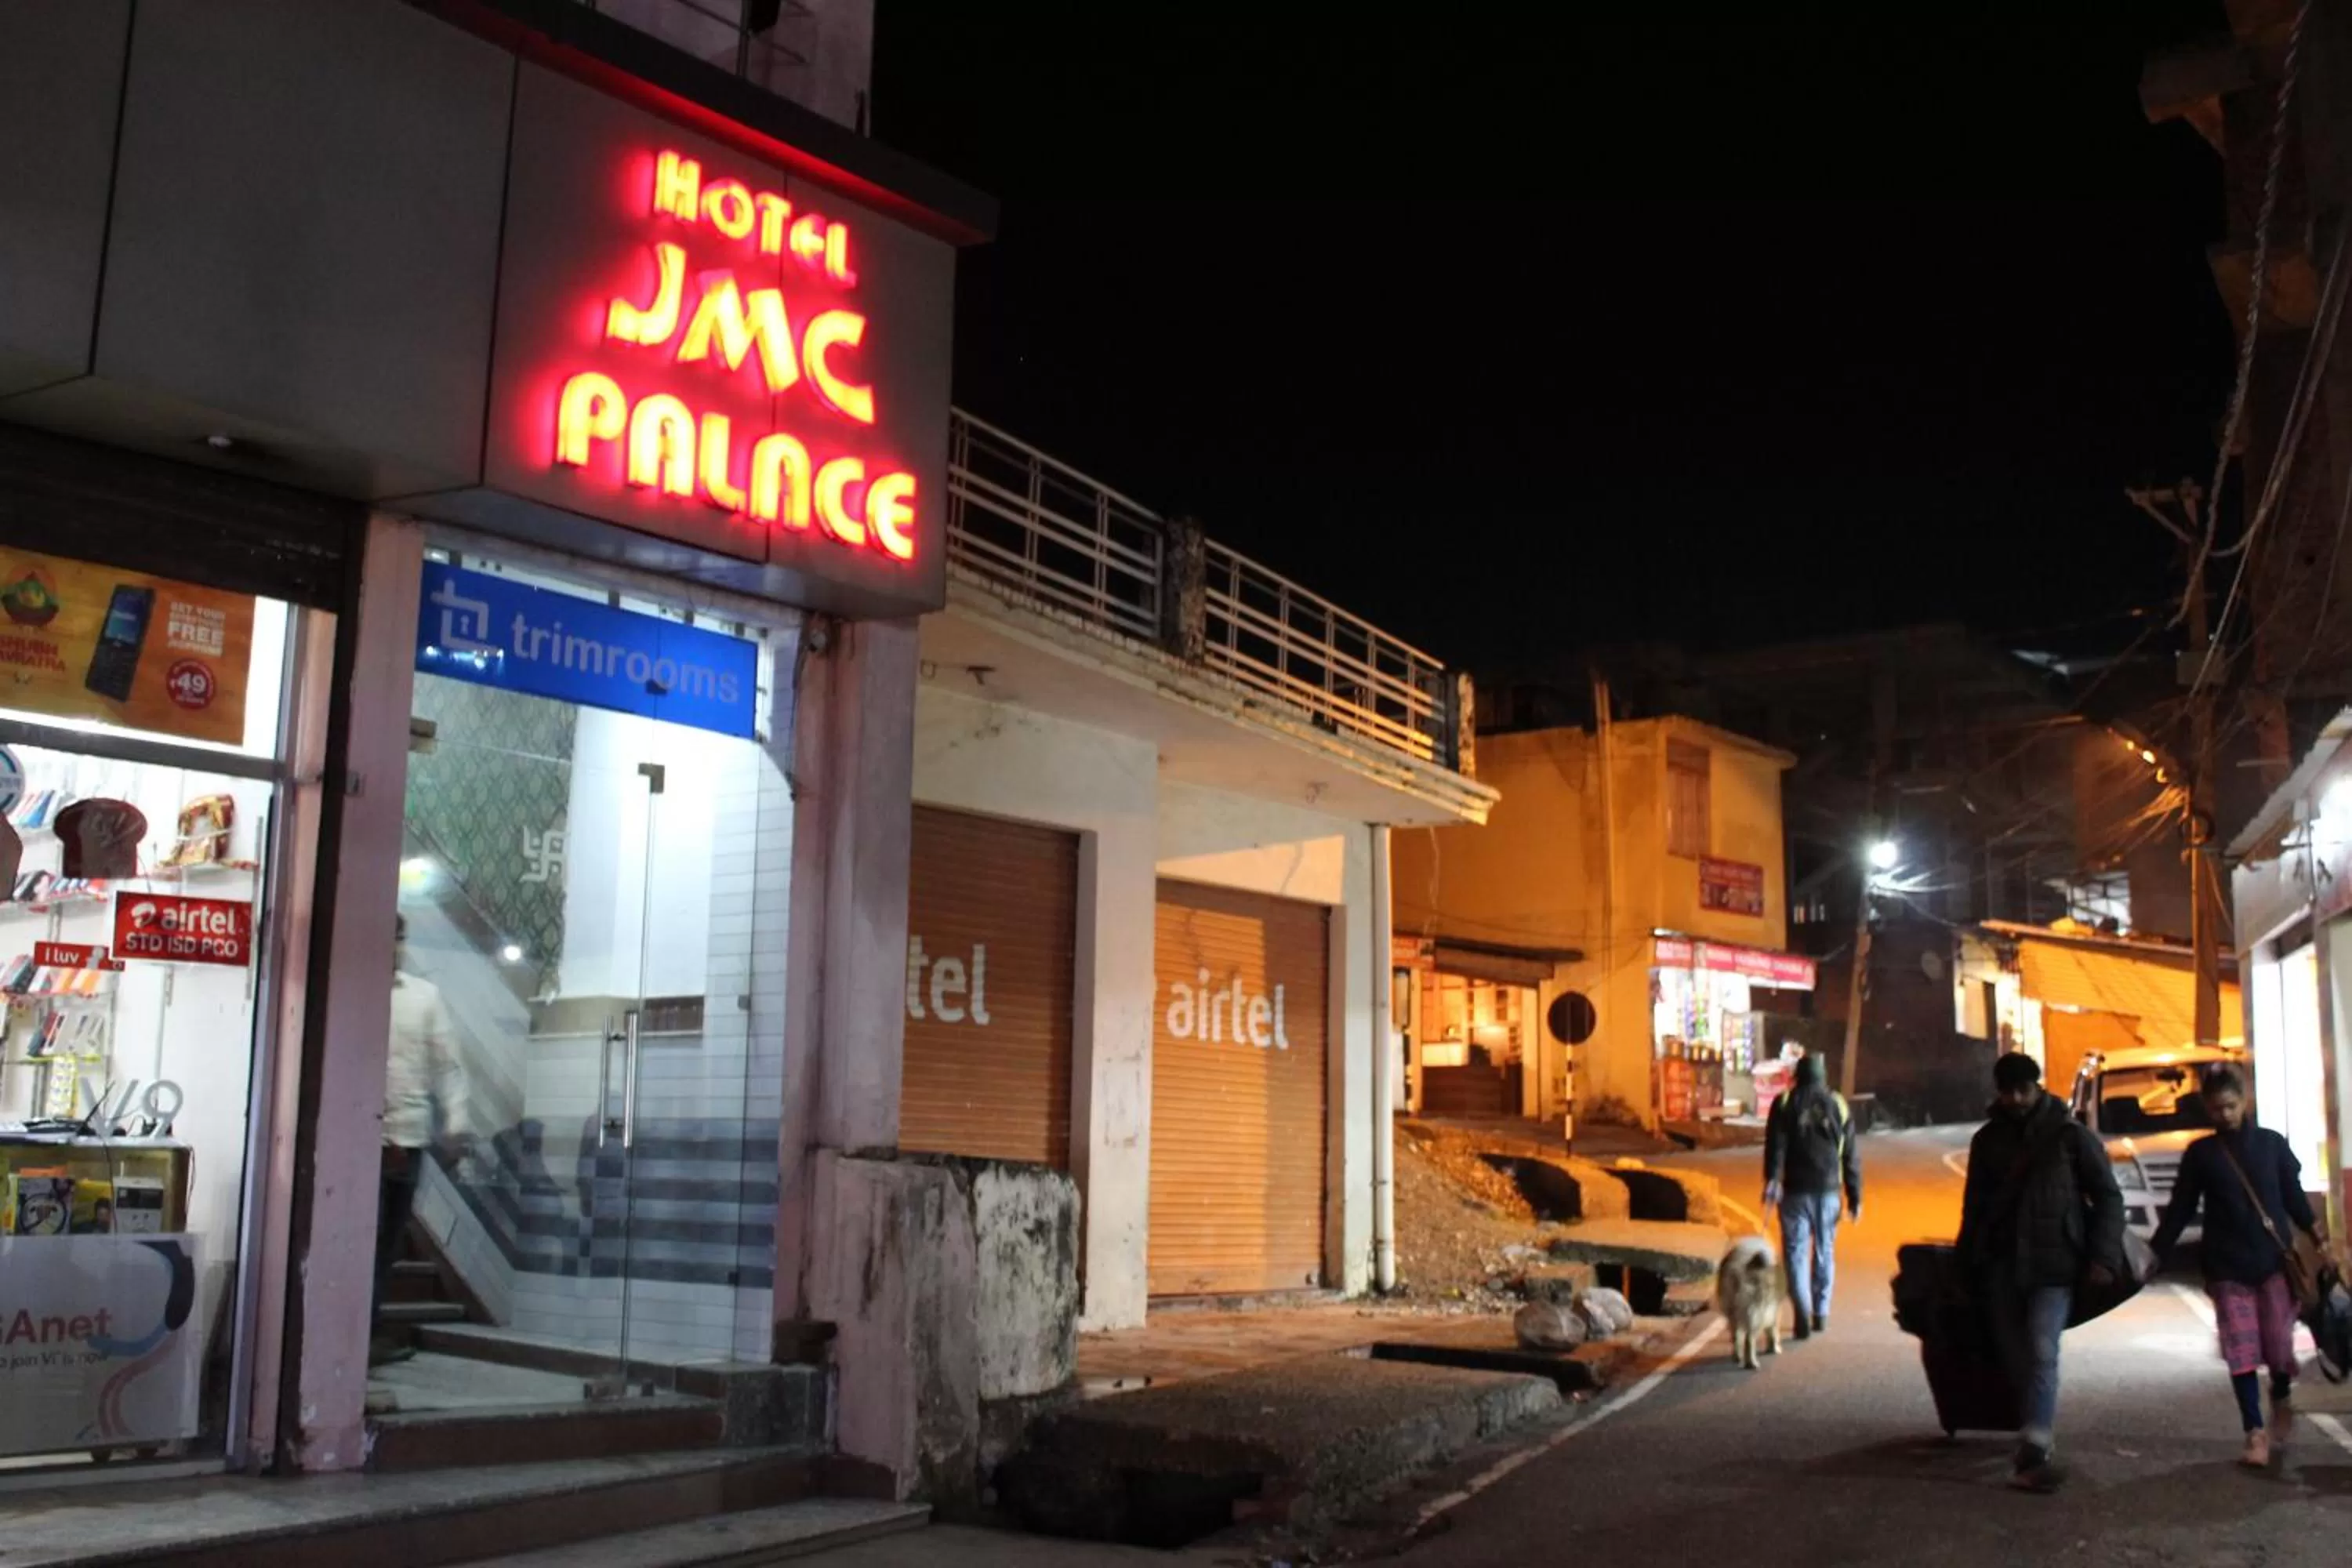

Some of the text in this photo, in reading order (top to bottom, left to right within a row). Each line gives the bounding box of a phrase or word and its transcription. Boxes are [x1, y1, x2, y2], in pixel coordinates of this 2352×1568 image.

[652, 149, 857, 287] HOTEL
[605, 241, 875, 425] JMC
[556, 372, 916, 561] PALACE
[167, 621, 225, 647] FREE
[510, 612, 739, 703] trimrooms
[125, 932, 238, 957] STD ISD PCO
[161, 902, 236, 935] airtel
[54, 946, 79, 964] luv
[1166, 967, 1289, 1051] airtel
[0, 1308, 112, 1345] Anet
